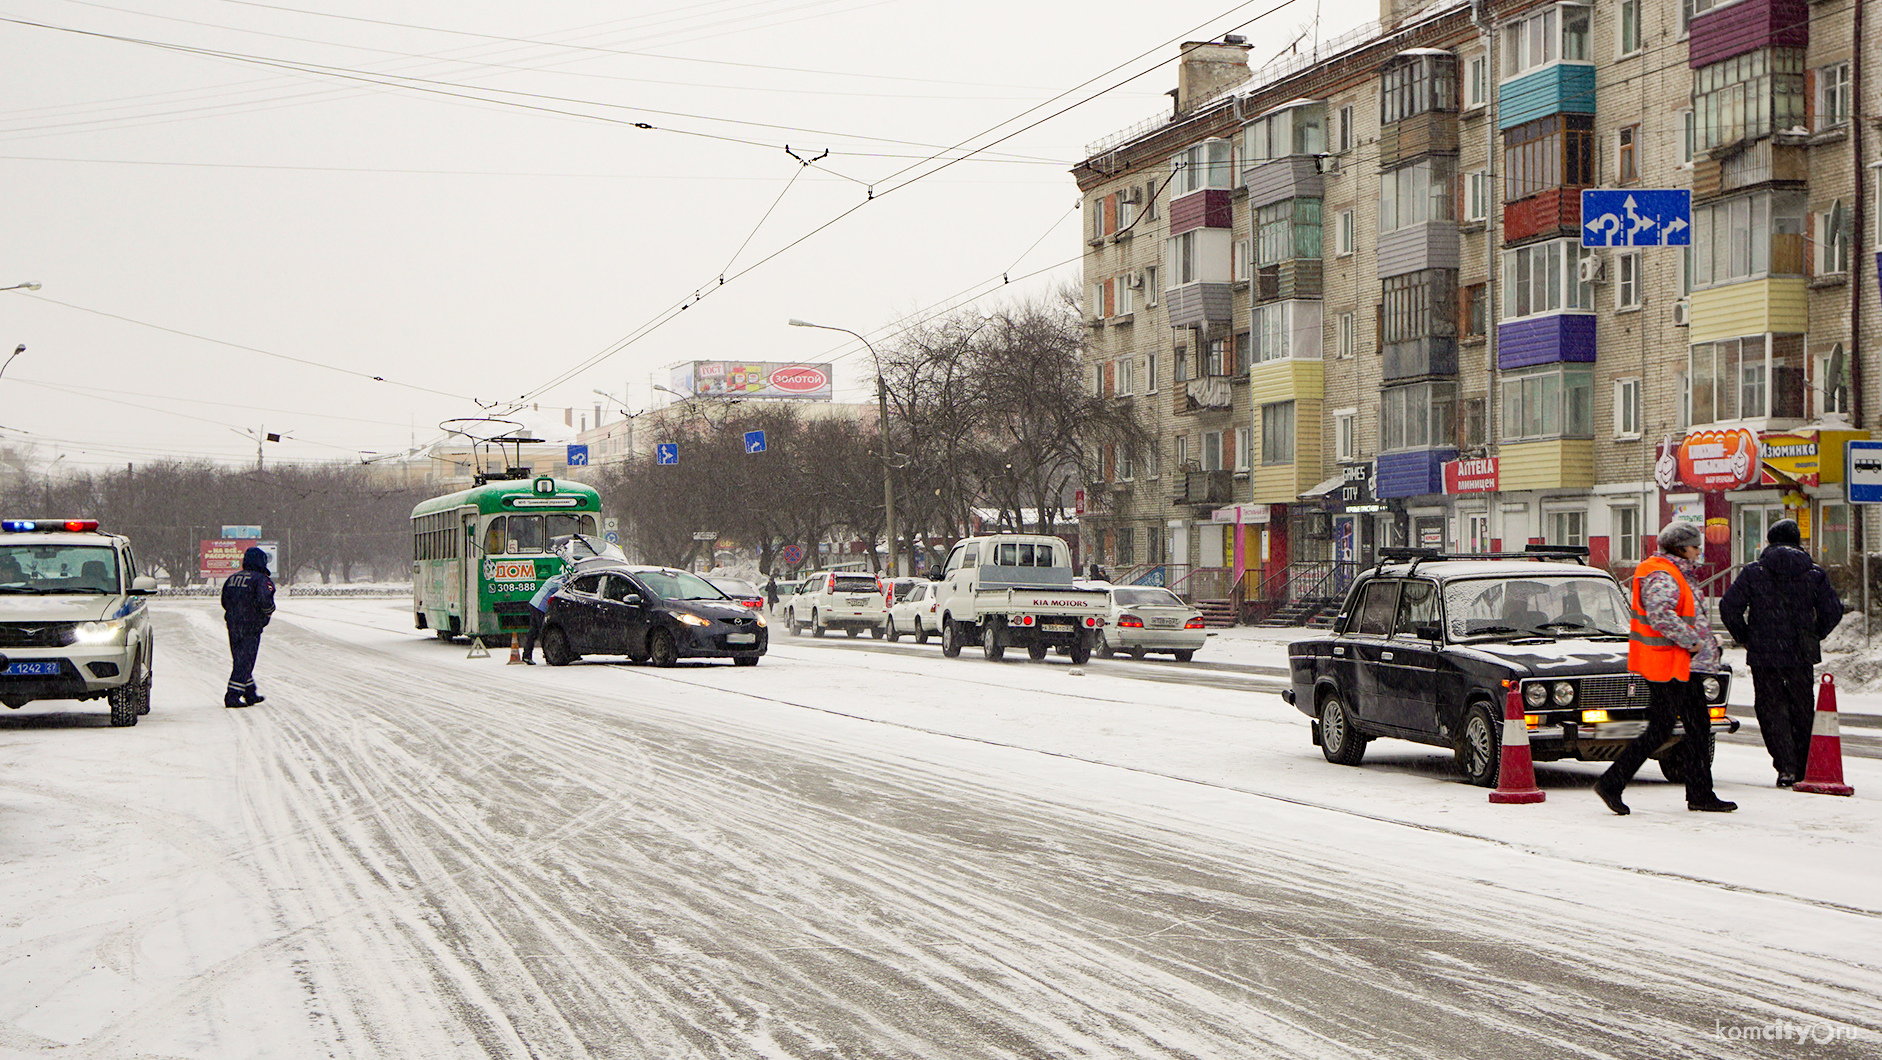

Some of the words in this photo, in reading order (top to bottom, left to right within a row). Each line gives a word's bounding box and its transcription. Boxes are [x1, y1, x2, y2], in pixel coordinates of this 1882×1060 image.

[701, 364, 722, 375] ГОСТ
[775, 373, 822, 385] ЗОЛОТОЙ
[1342, 466, 1365, 481] GAMES
[1457, 459, 1494, 476] АПТЕКА
[1342, 486, 1358, 501] CITY
[496, 565, 534, 577] ДОМ
[497, 583, 536, 592] 308-888
[16, 663, 42, 673] 1242
[46, 662, 56, 671] 27
